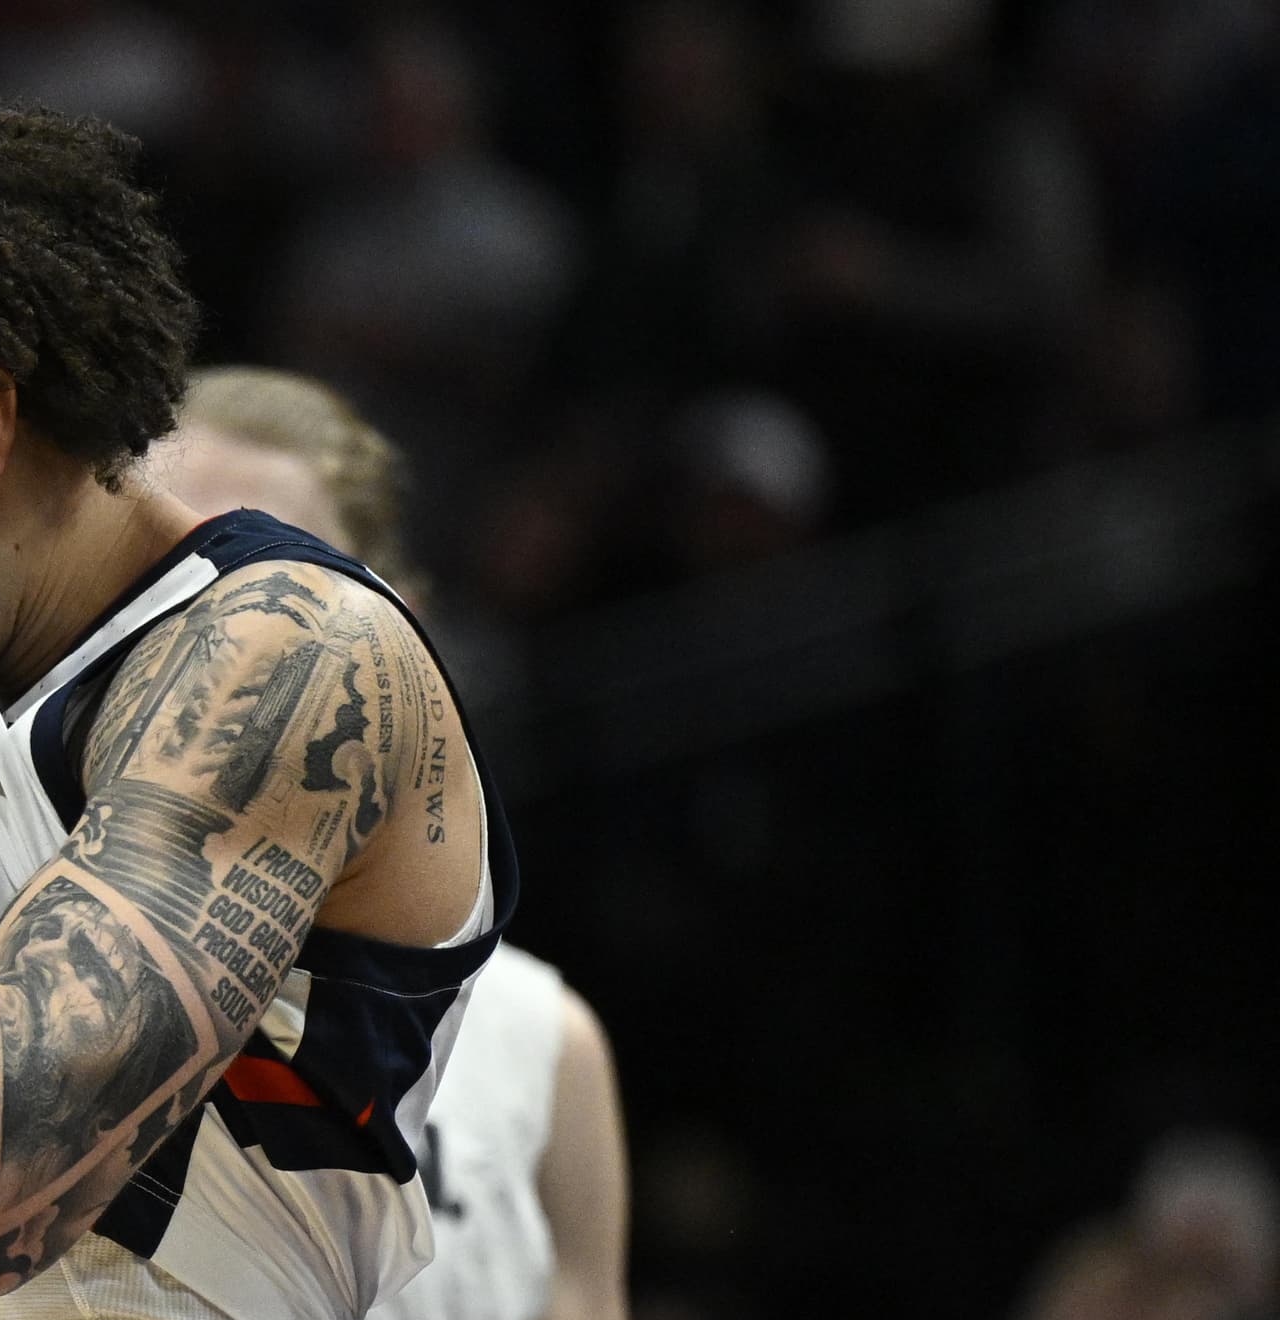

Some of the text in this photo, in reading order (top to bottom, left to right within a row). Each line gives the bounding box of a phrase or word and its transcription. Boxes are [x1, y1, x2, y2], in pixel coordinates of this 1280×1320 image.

[425, 736, 446, 843] NEWS
[241, 835, 269, 861] I
[254, 843, 324, 901] PRAYED
[207, 894, 255, 936] GOD
[248, 919, 293, 970] GAVE
[221, 863, 305, 933] WISDOM
[193, 921, 277, 1006] PROBLEMS
[210, 976, 256, 1032] SOLVE
